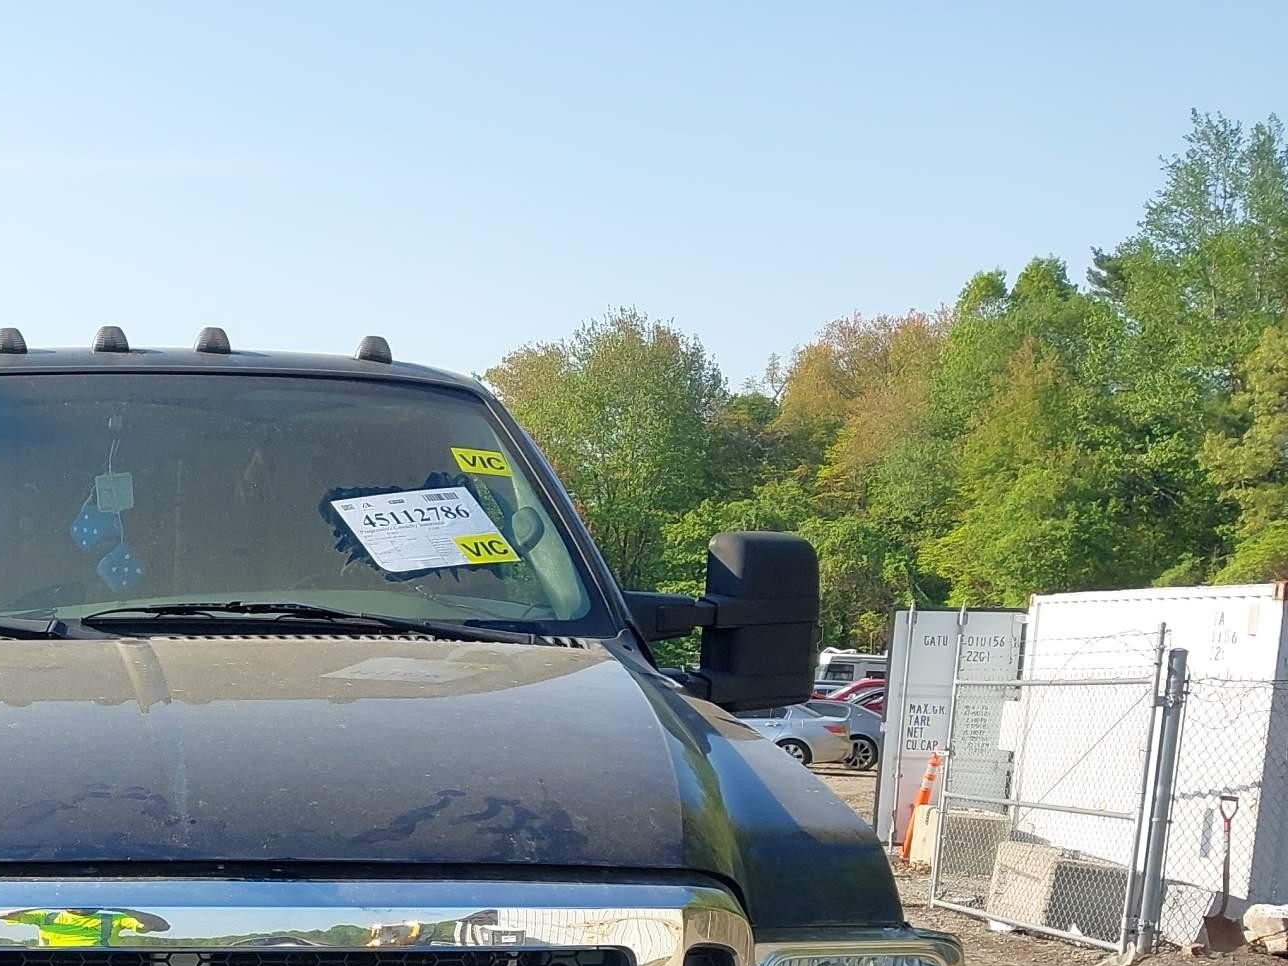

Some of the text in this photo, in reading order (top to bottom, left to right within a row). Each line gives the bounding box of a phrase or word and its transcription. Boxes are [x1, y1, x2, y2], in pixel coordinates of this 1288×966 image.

[459, 453, 505, 471] VIC
[363, 503, 470, 528] 45112786
[460, 539, 509, 558] VIC
[924, 635, 949, 647] GATU
[909, 715, 931, 727] TARE
[906, 726, 924, 739] NET
